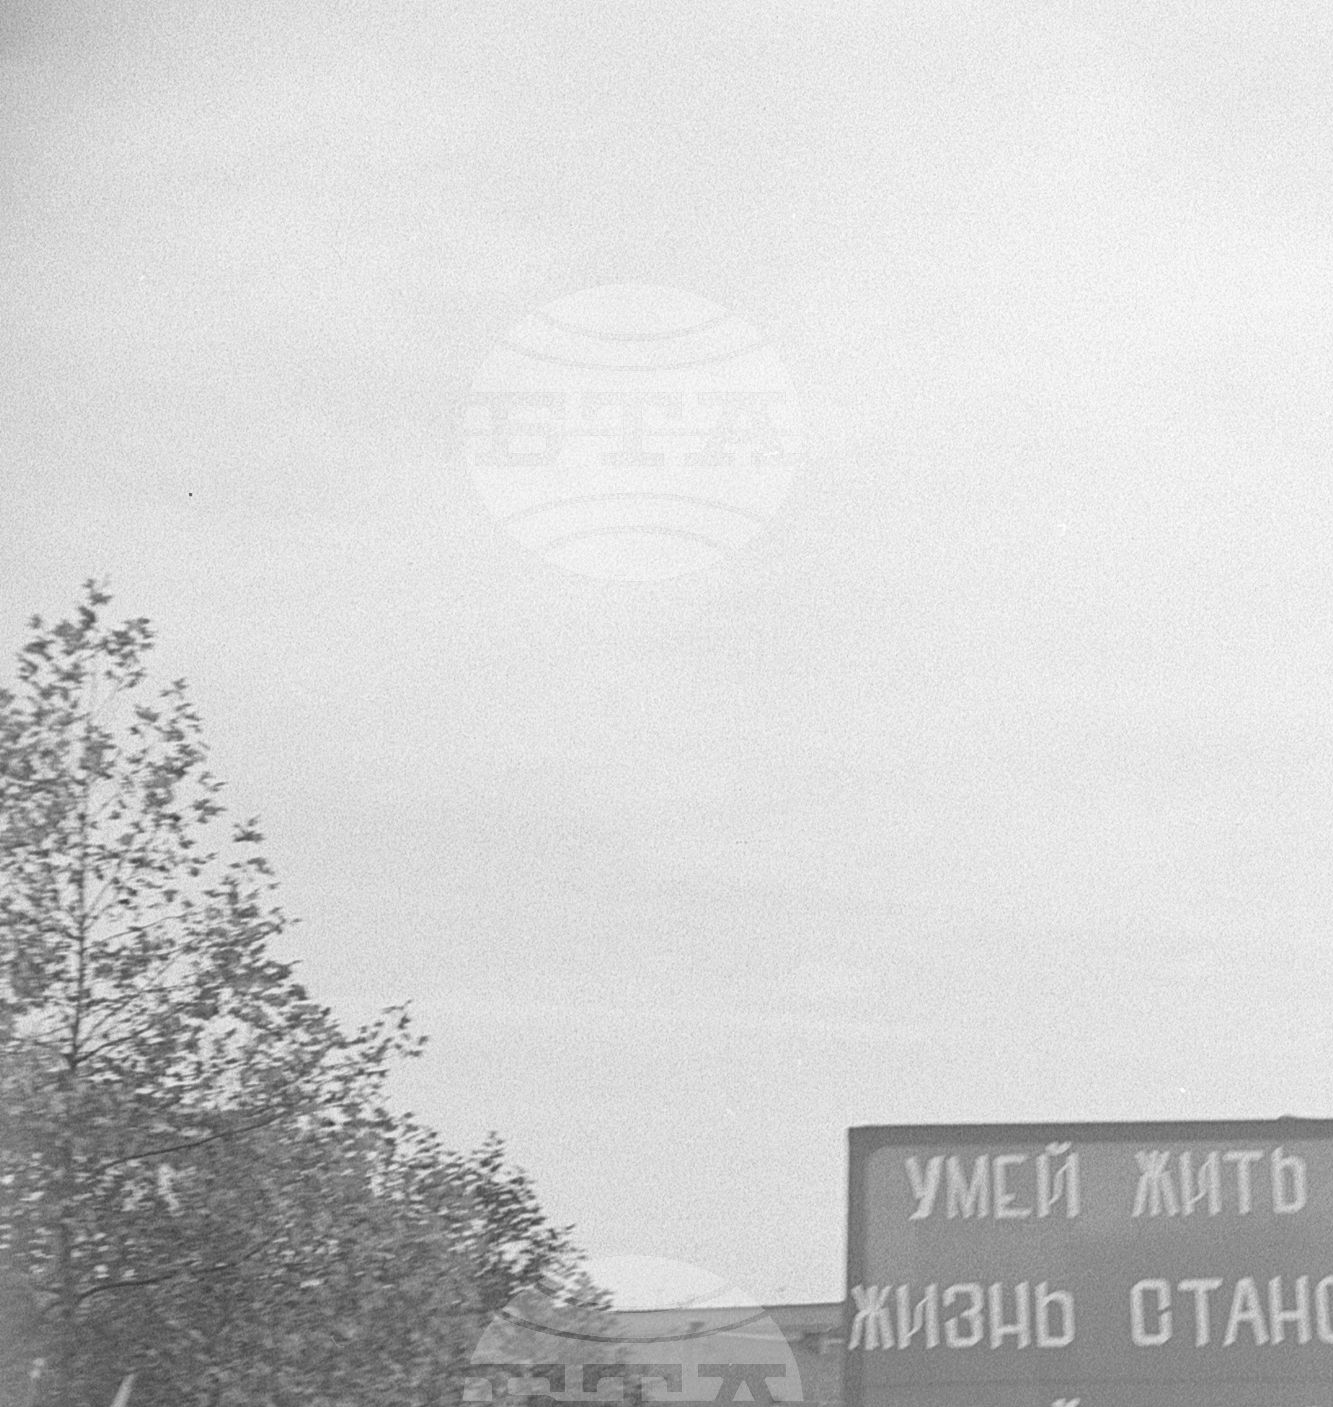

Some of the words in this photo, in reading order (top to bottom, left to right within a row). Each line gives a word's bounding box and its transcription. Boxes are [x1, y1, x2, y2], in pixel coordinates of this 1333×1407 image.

[905, 1142, 1081, 1220] УМЕЙ
[1132, 1147, 1308, 1218] ЖИТЬ
[849, 1281, 1076, 1350] ЖИЗНЬ
